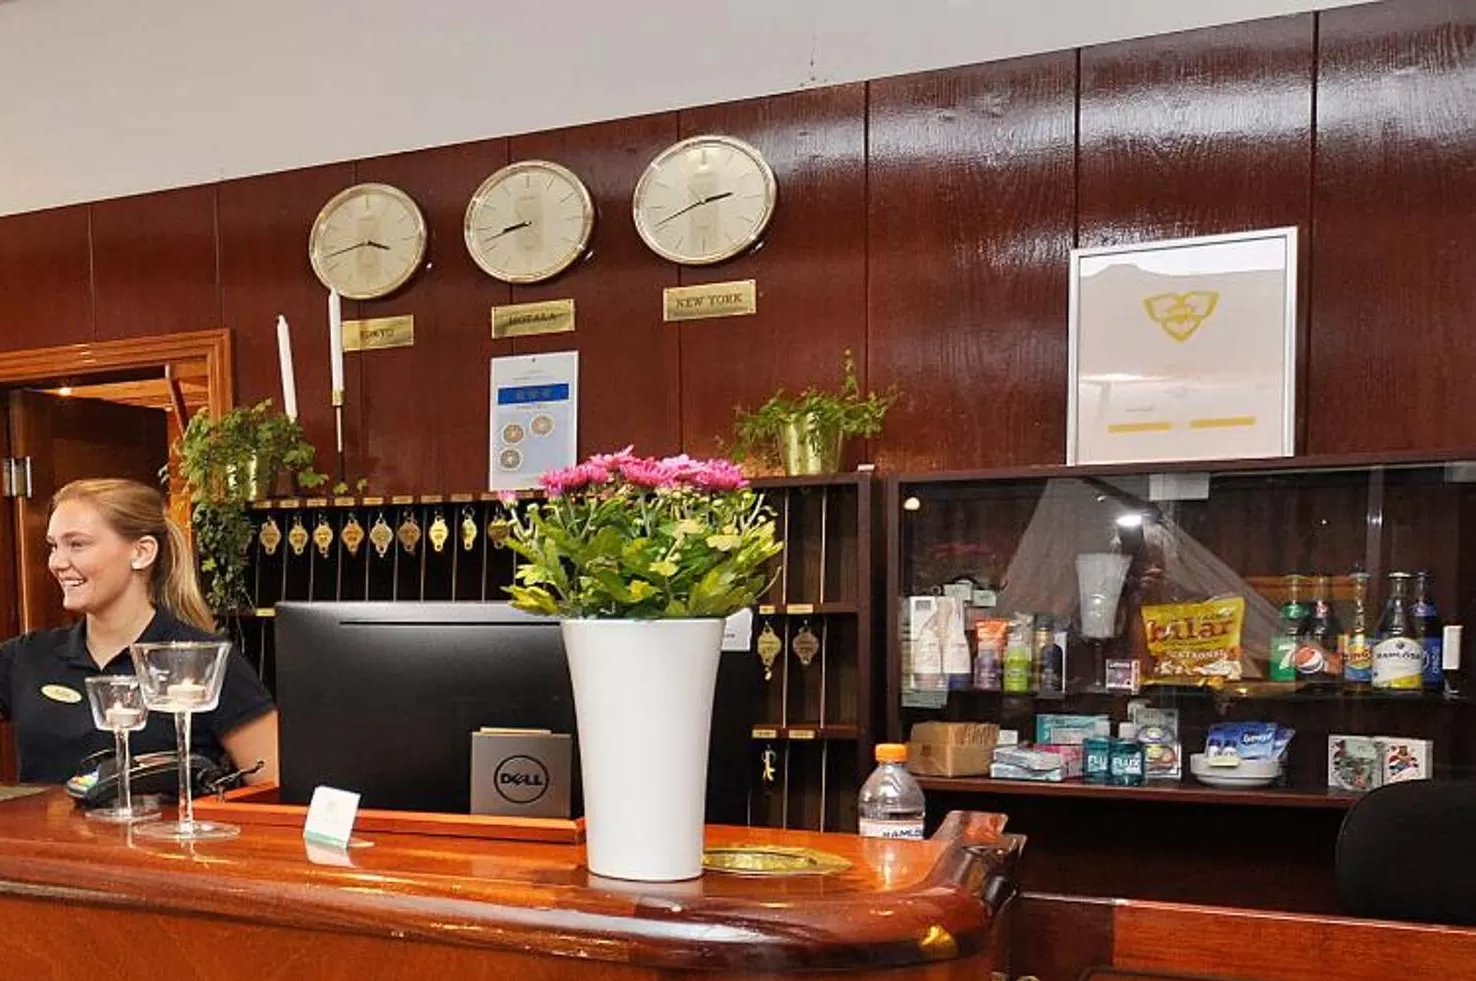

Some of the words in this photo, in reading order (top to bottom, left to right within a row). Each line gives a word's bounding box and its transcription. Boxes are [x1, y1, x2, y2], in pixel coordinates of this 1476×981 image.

[676, 297, 704, 308] NEW
[707, 293, 743, 305] YORK
[500, 773, 543, 786] DELL
